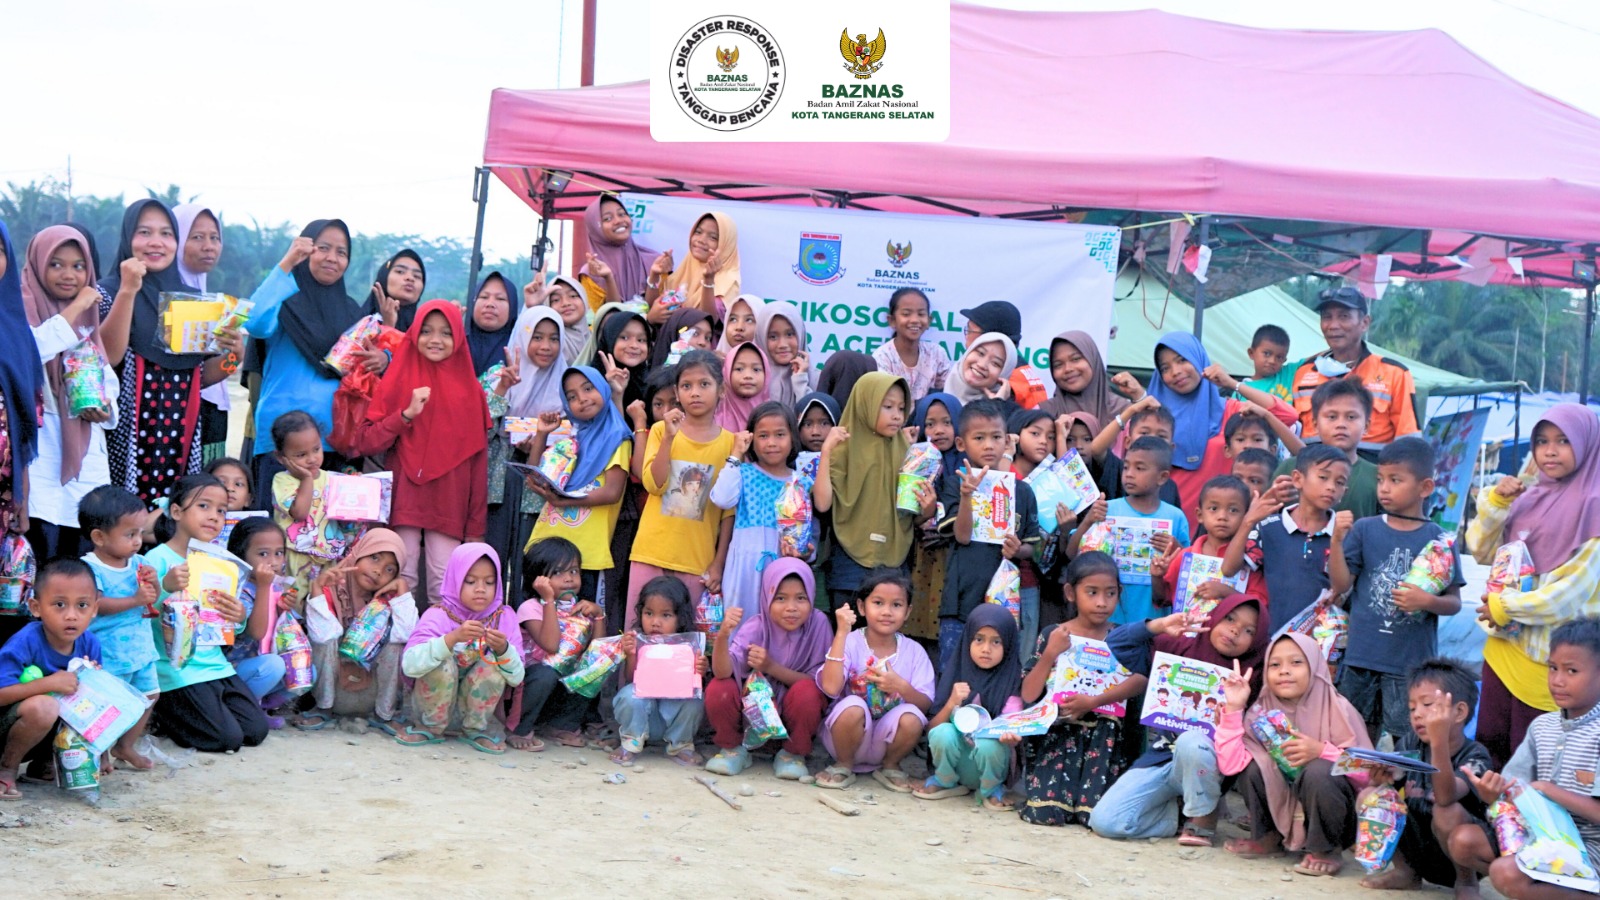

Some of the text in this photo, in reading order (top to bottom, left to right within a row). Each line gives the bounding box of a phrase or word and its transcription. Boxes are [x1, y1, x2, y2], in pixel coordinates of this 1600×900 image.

[875, 269, 920, 280] BAZNAS
[820, 333, 894, 356] ACE
[1153, 716, 1210, 735] Aktivitasku
